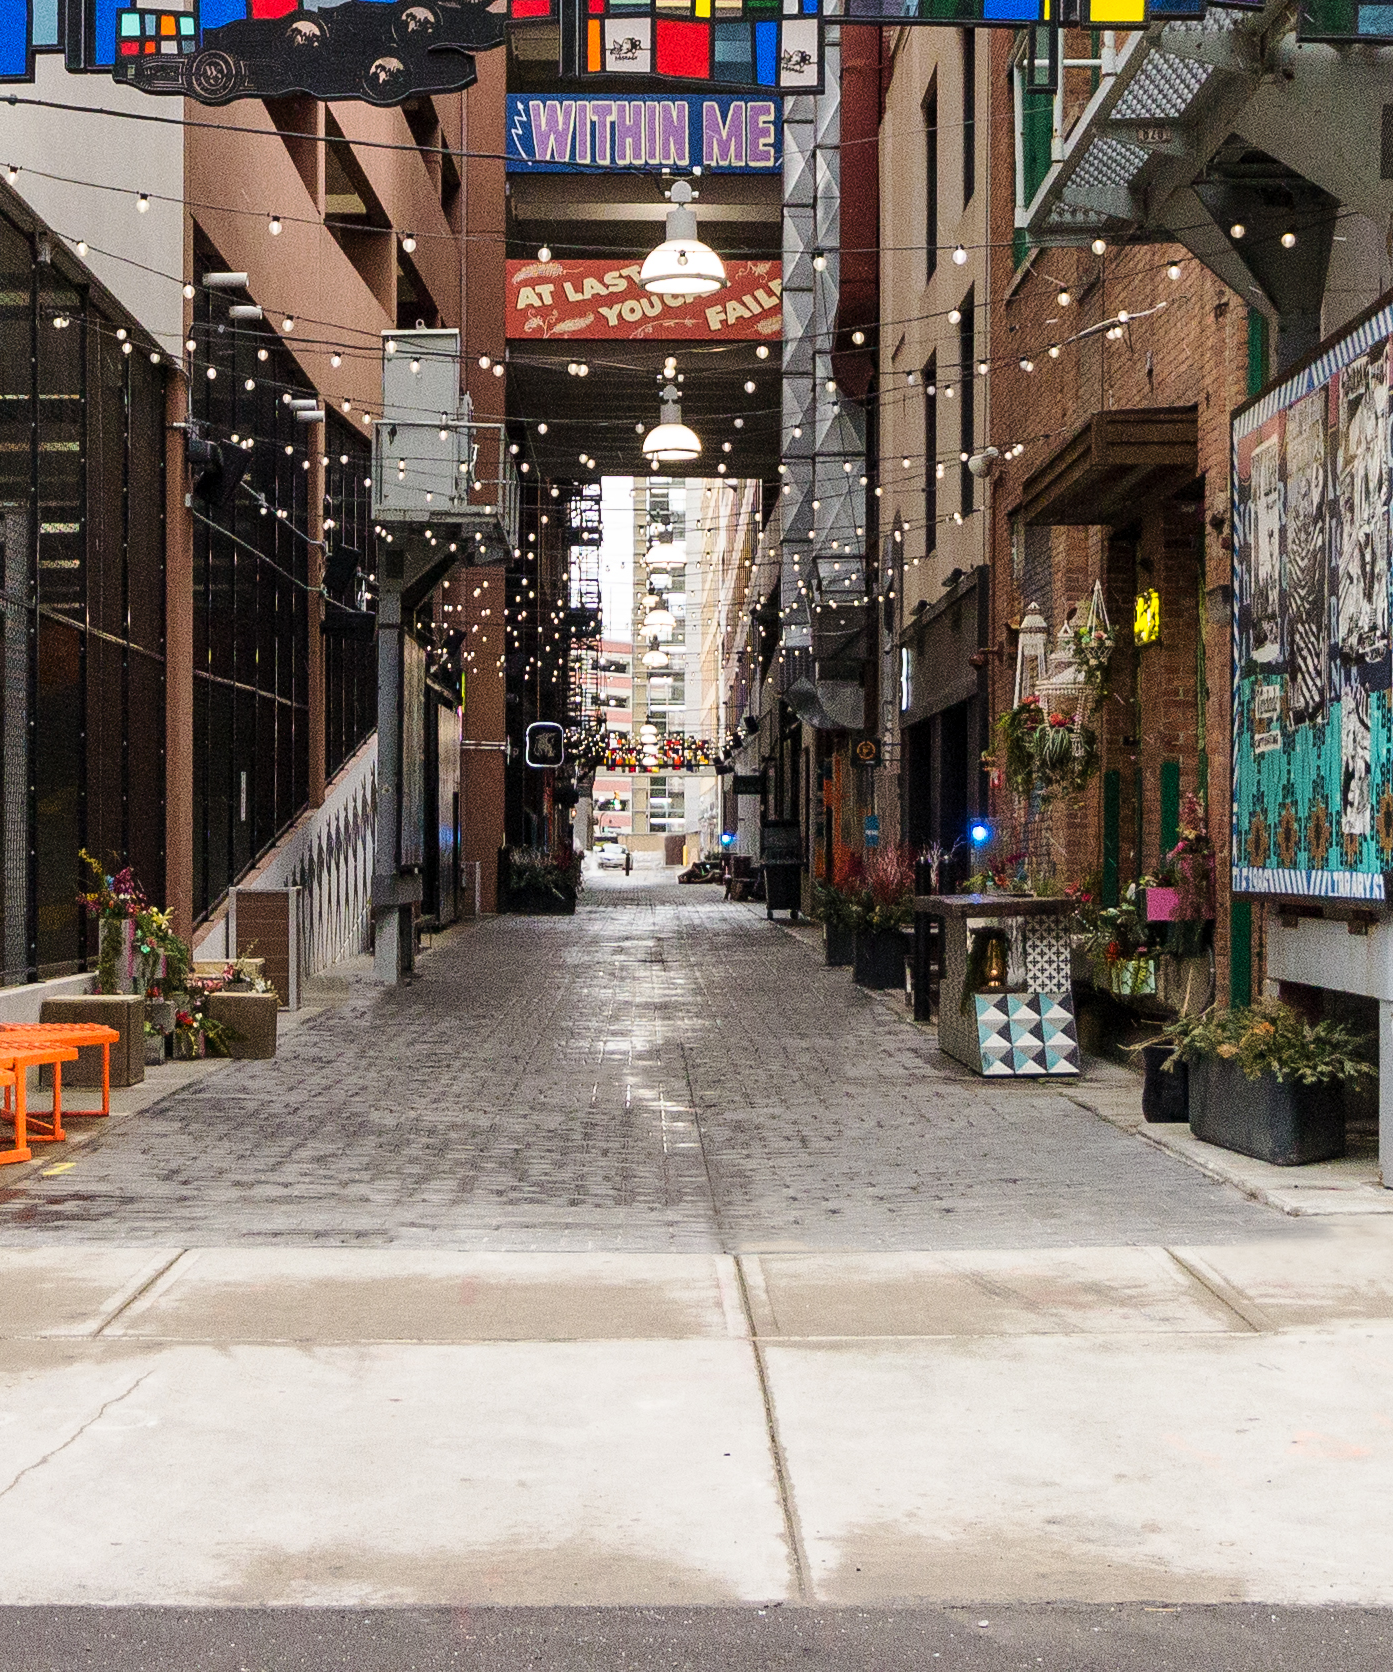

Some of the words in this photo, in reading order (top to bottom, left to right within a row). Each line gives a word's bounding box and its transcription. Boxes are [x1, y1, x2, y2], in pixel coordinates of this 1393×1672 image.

[529, 100, 689, 166] WITHIN
[703, 100, 775, 167] ME
[516, 285, 555, 310] AT
[563, 266, 642, 302] LAST
[598, 296, 660, 326] YOU
